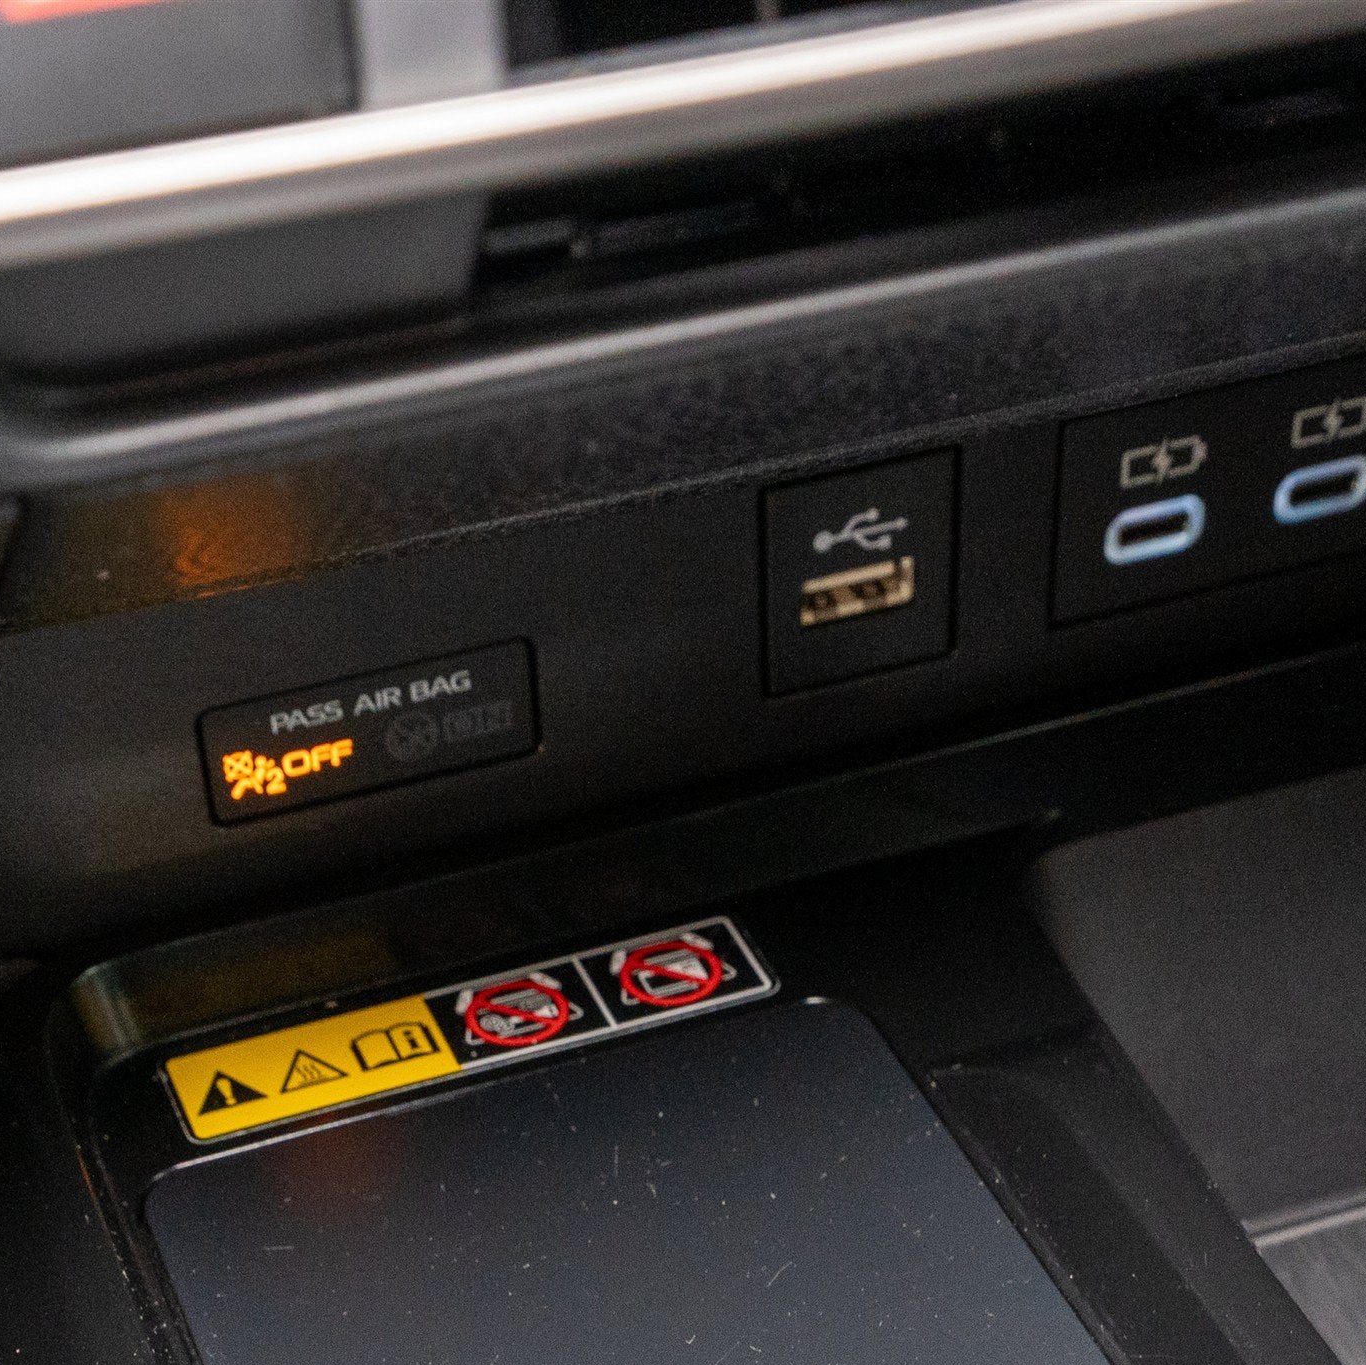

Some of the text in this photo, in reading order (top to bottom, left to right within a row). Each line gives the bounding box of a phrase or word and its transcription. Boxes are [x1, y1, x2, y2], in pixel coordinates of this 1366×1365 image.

[269, 670, 472, 735] PASS AIR BAG
[282, 738, 353, 778] OFF
